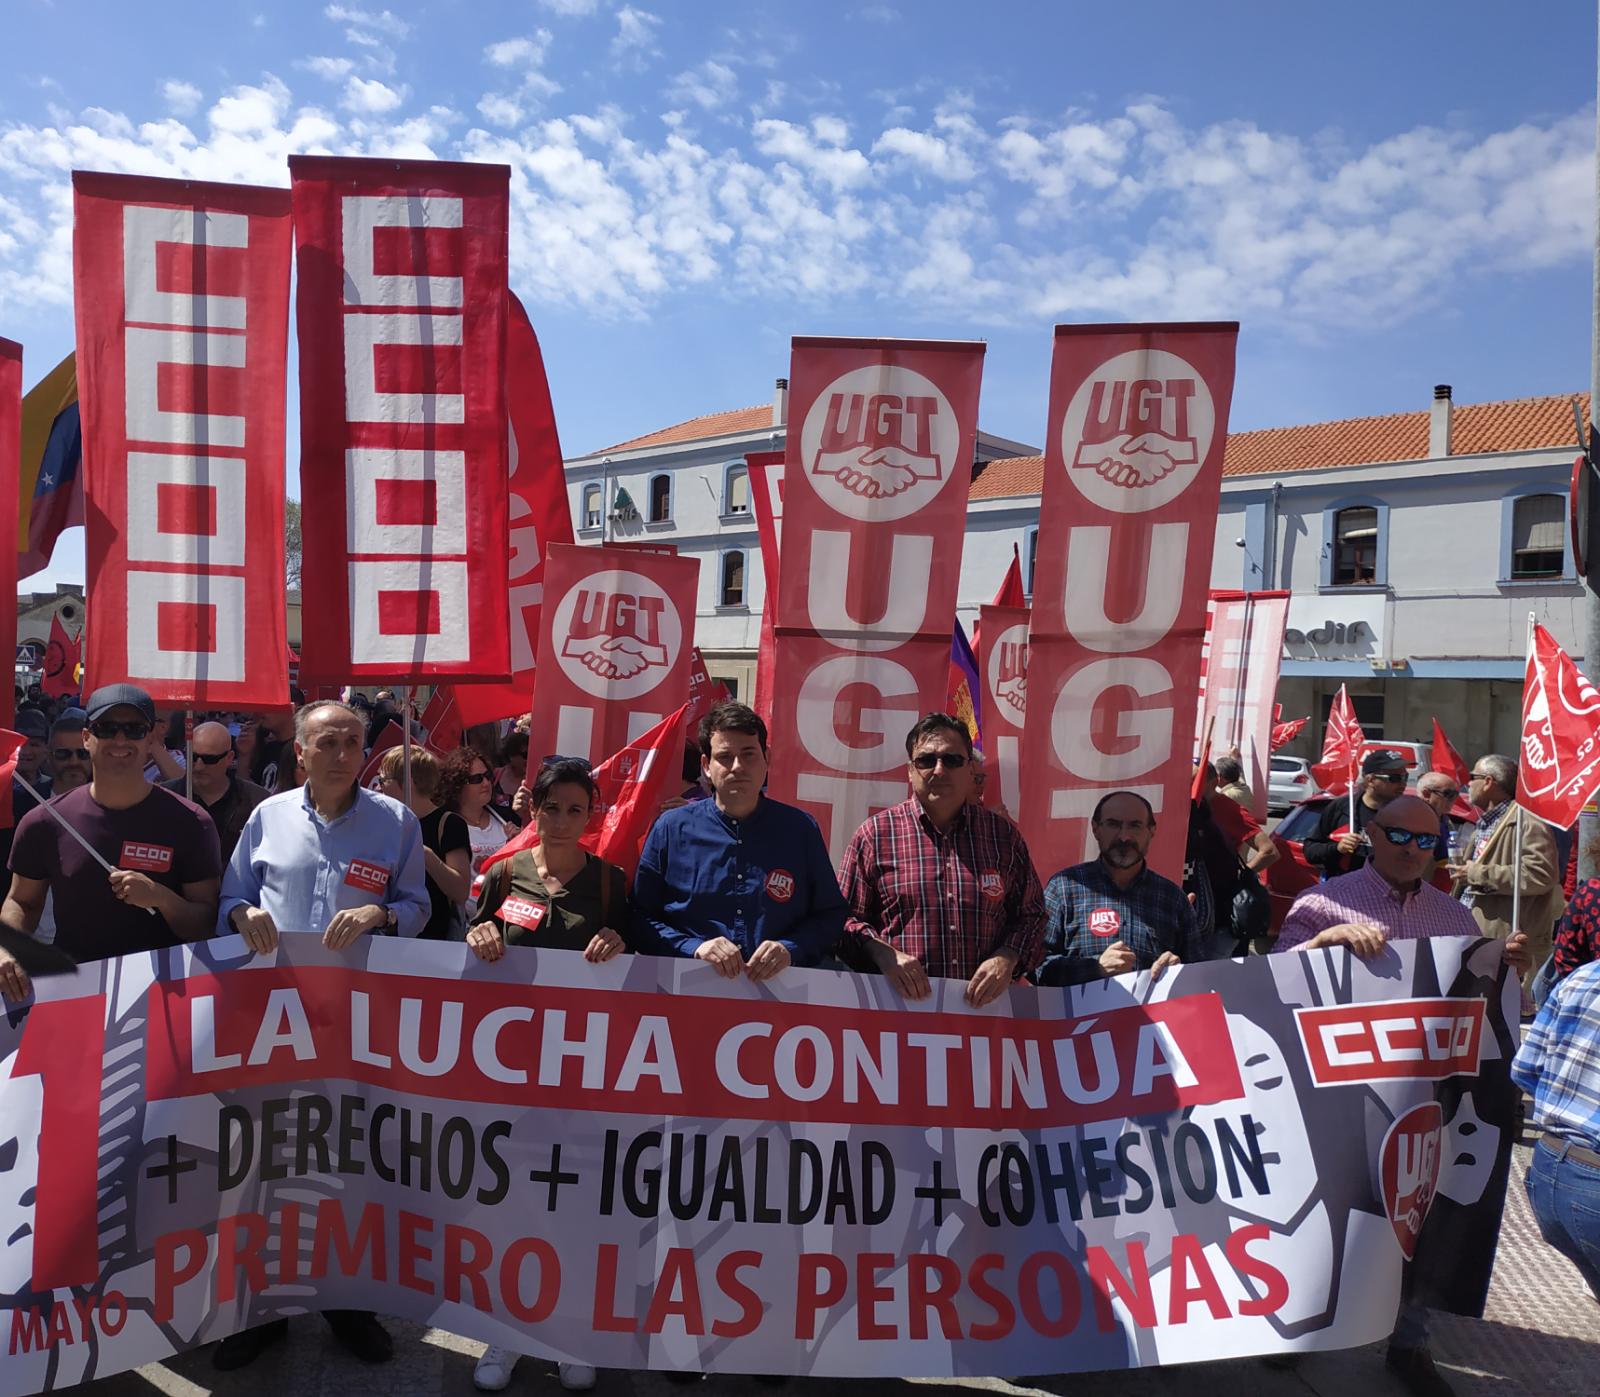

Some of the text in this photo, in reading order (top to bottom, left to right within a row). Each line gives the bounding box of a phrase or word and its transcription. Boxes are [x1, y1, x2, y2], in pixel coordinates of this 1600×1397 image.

[342, 196, 470, 664] CCOO
[821, 393, 938, 456] UGT
[1083, 378, 1196, 438] UGT
[123, 205, 249, 682] CCOO
[568, 591, 667, 637] UGT
[796, 529, 934, 870] UGT
[125, 845, 171, 861] CCOO
[350, 863, 389, 884] CCOO
[769, 872, 793, 892] UGT
[982, 874, 1000, 887] UGT
[502, 900, 542, 919] CCOO
[1091, 911, 1115, 926] UGT
[191, 988, 1200, 1109] LA LUCHA CONTINÚA
[1319, 1016, 1474, 1067] CCOO
[10, 994, 106, 1292] 1
[218, 1095, 512, 1206] DERECHOS
[599, 1129, 896, 1226] IGUALDAD
[154, 1199, 1290, 1341] PRIMERO LAS PERSONAS
[8, 1291, 128, 1356] MAYO
